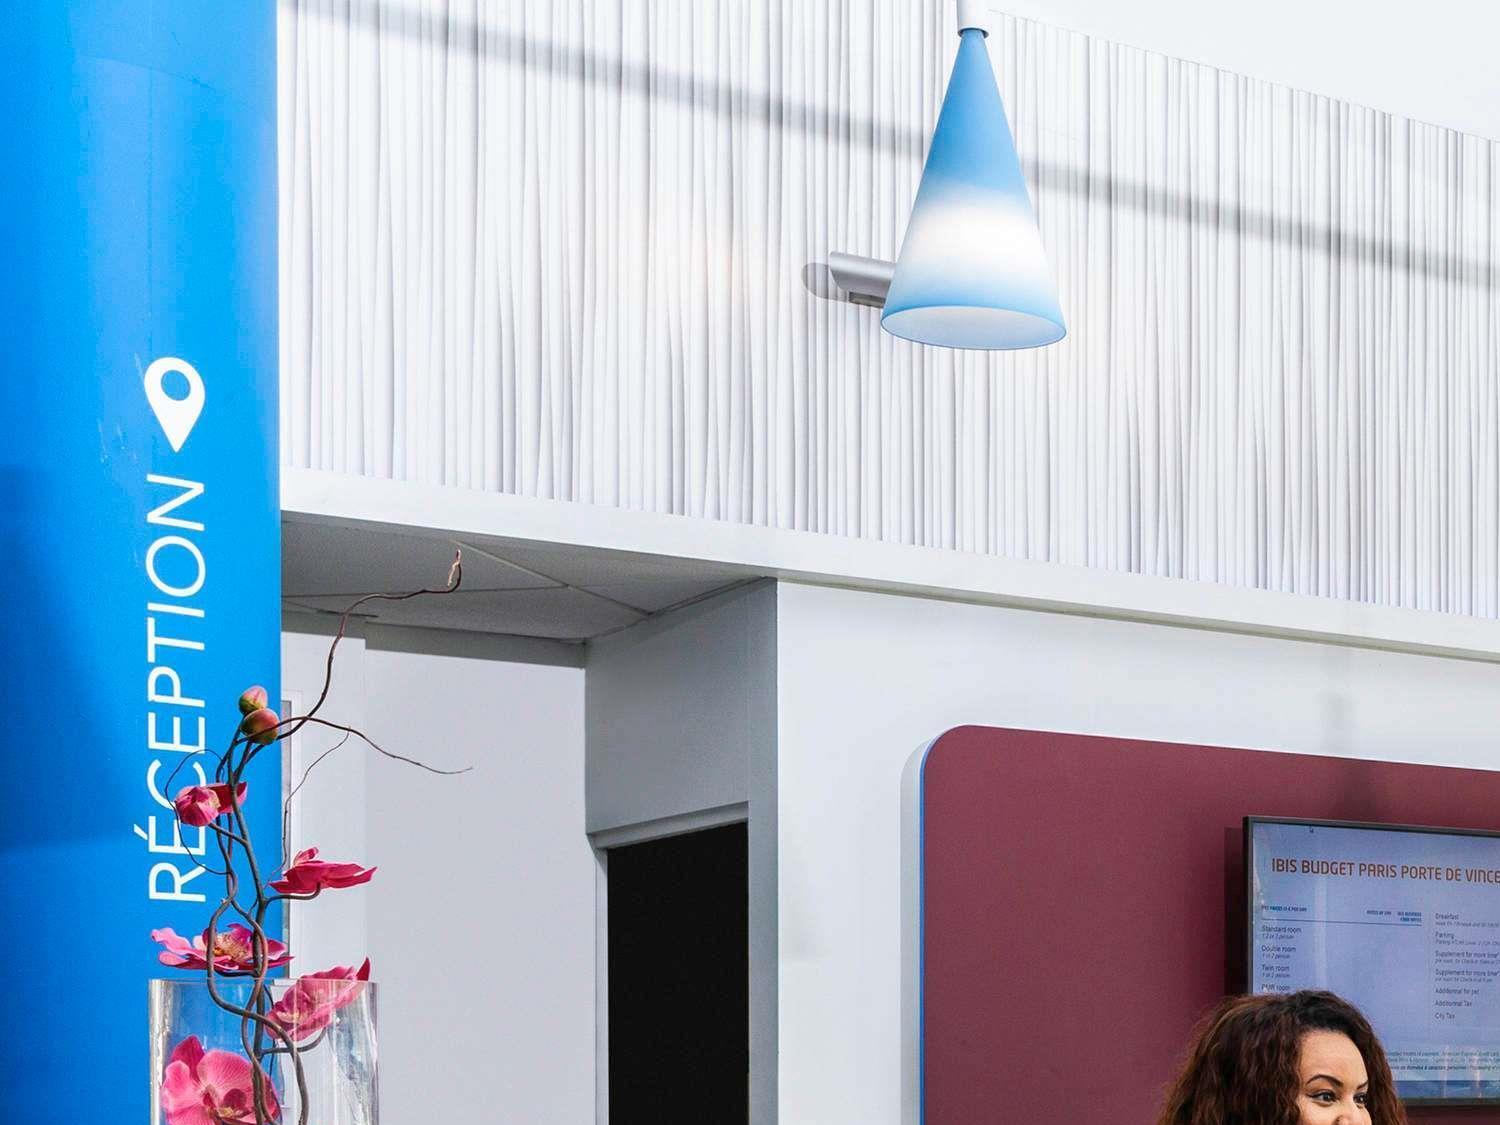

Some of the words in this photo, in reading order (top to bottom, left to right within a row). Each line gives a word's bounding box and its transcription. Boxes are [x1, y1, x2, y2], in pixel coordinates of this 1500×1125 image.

[133, 473, 208, 903] RÉCEPTION
[1271, 858, 1297, 873] IBIS
[1301, 860, 1355, 876] BUDGET
[1358, 862, 1397, 879] PARIS
[1401, 865, 1442, 881] PORTE
[1446, 867, 1462, 882] DE
